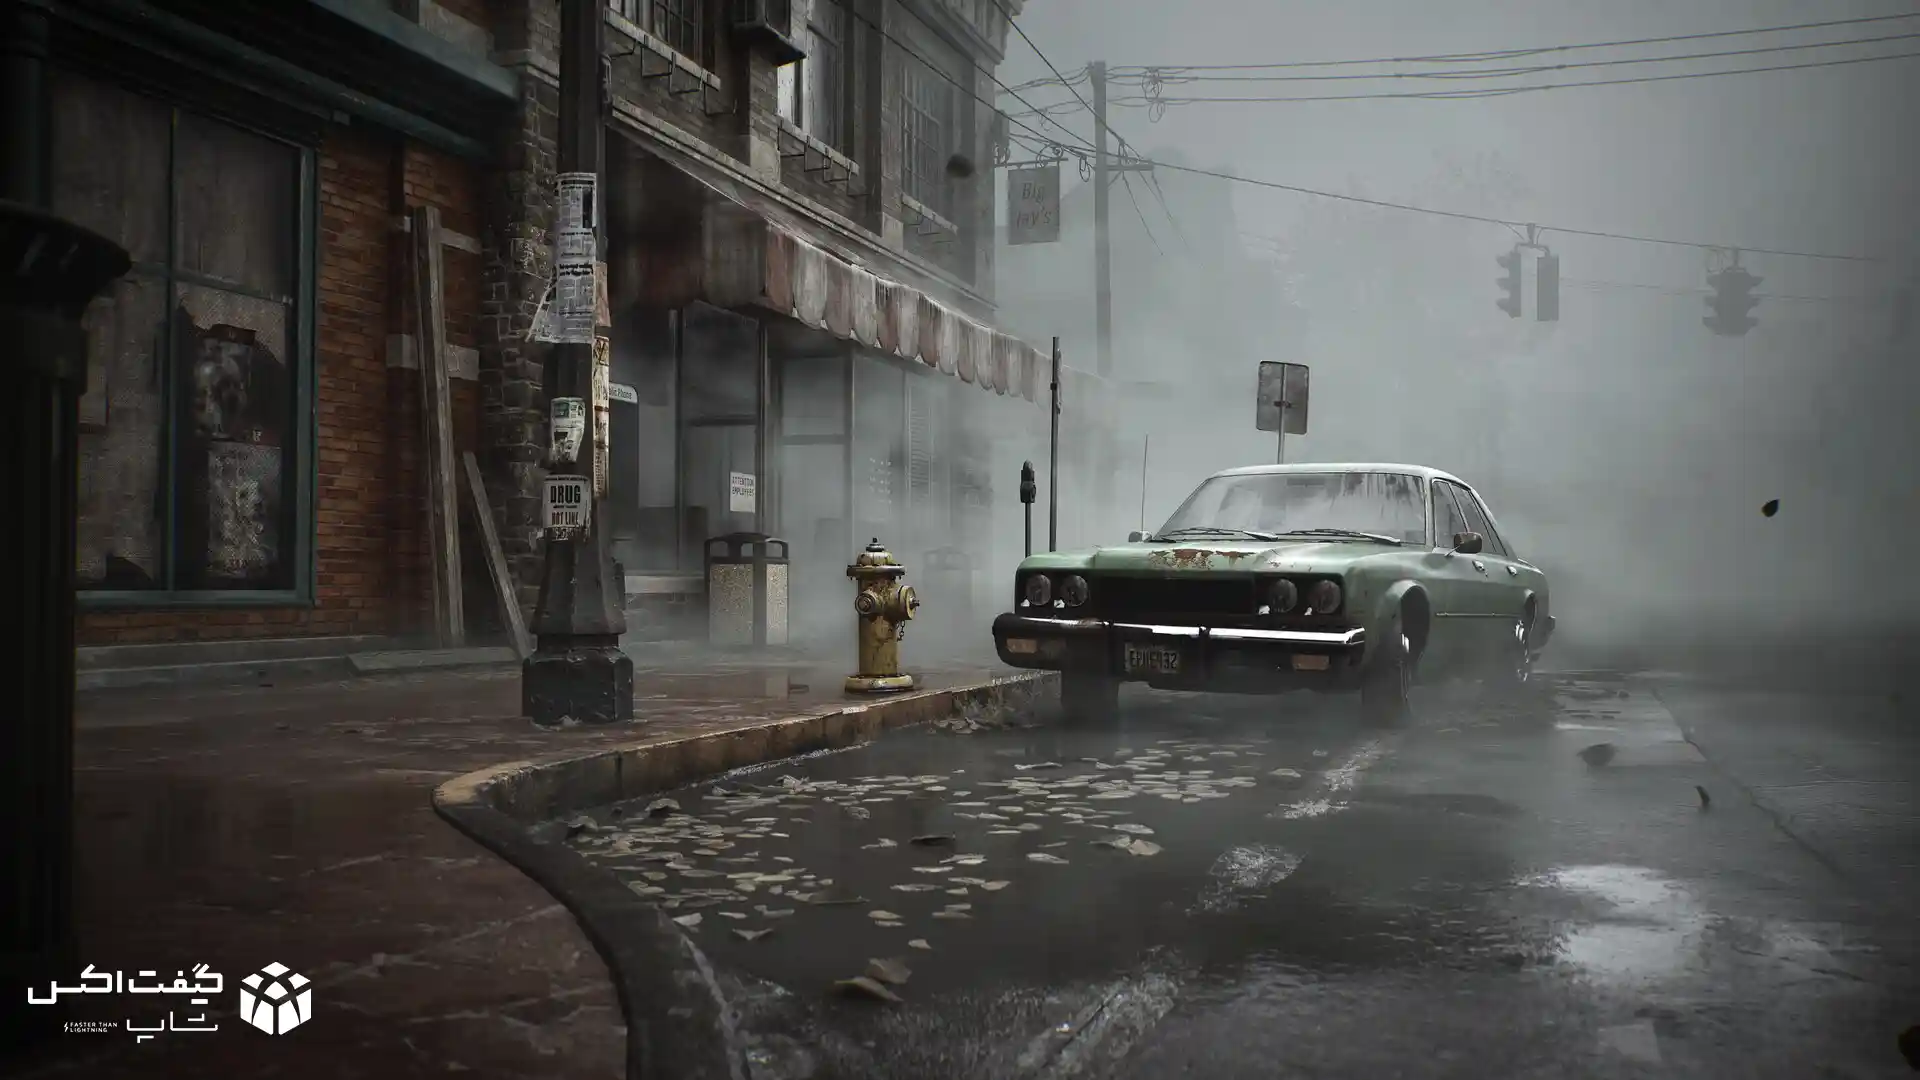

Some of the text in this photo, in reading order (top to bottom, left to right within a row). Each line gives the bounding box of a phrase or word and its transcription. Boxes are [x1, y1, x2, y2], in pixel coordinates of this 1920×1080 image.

[1023, 183, 1045, 203] Big
[618, 388, 632, 400] Phone
[732, 476, 754, 487] ATTENTION
[550, 485, 581, 504] DRUG
